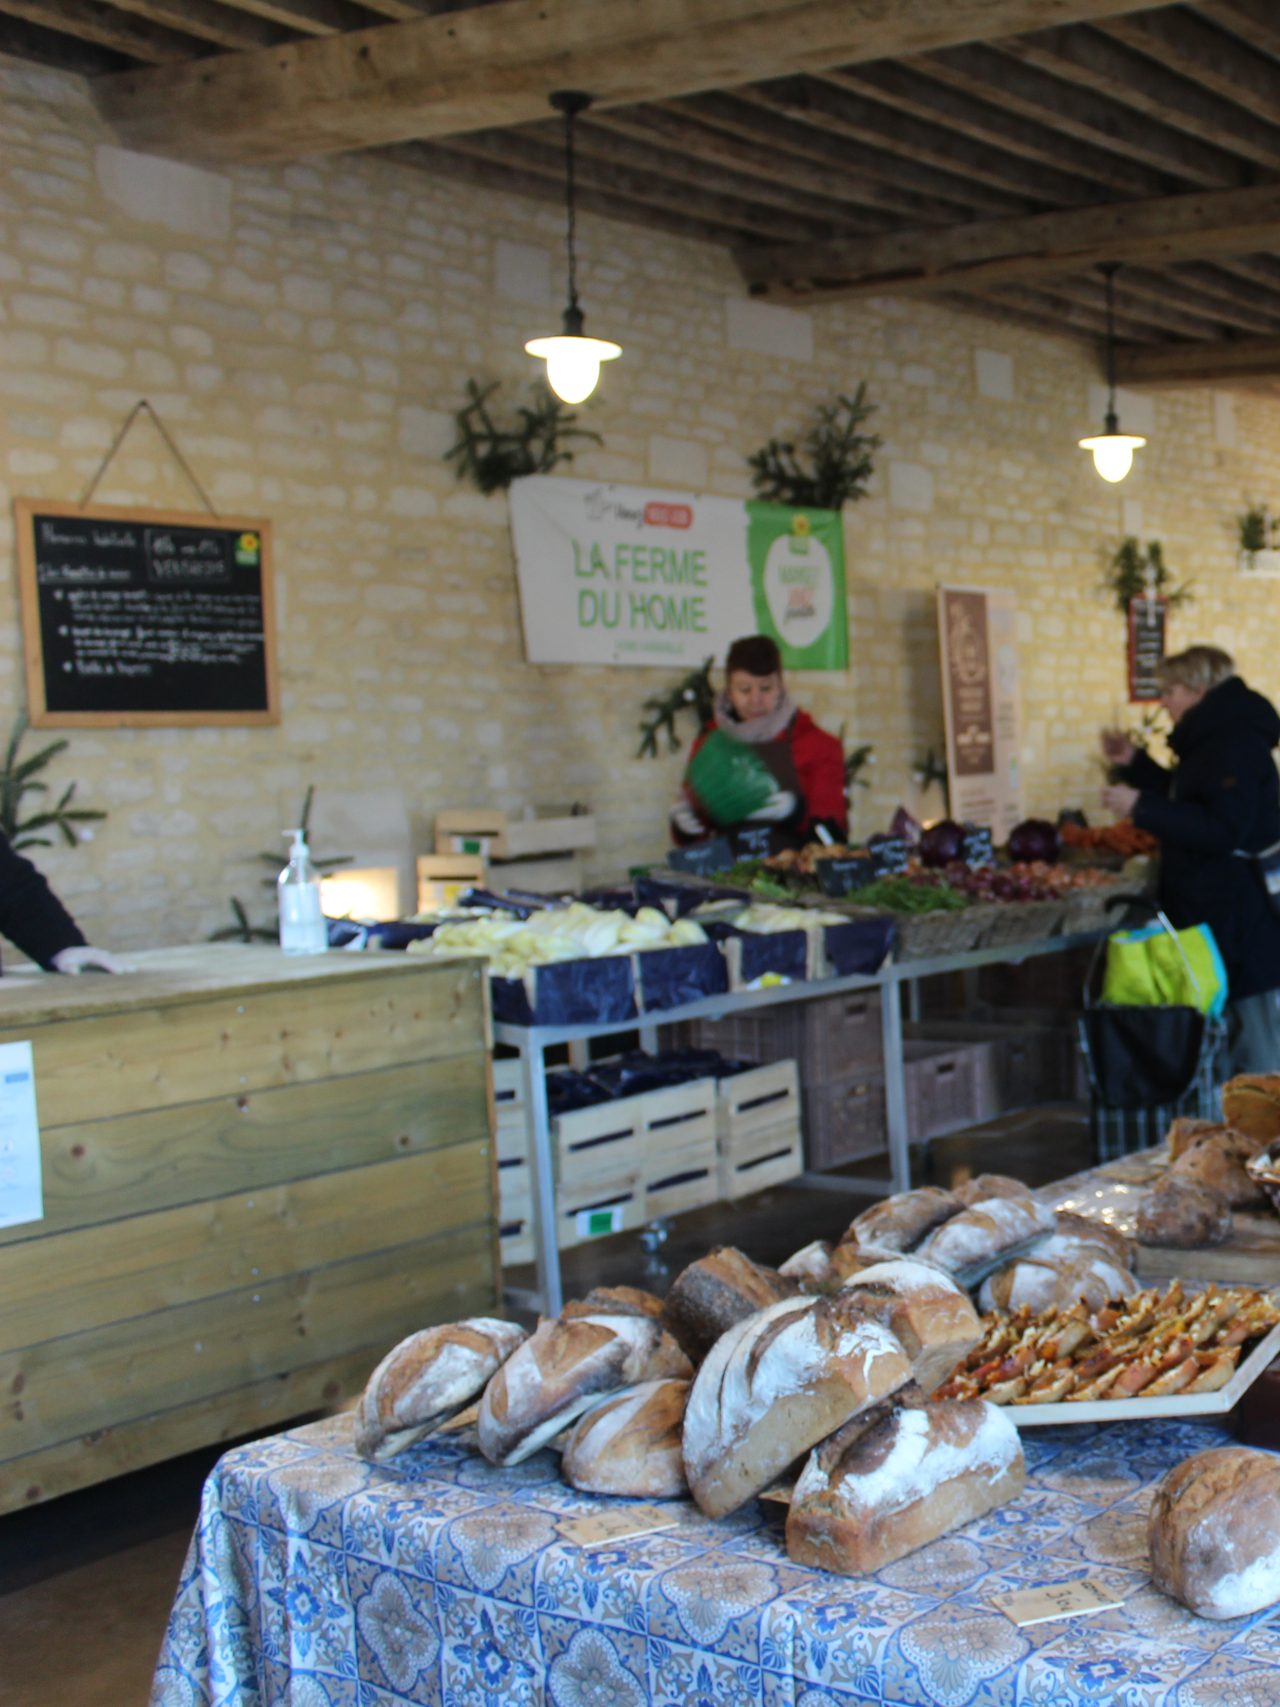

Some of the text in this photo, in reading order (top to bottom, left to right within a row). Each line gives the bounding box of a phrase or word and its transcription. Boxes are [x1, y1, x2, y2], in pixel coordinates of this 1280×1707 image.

[572, 539, 708, 586] LA FERME
[577, 588, 708, 634] DU HOME
